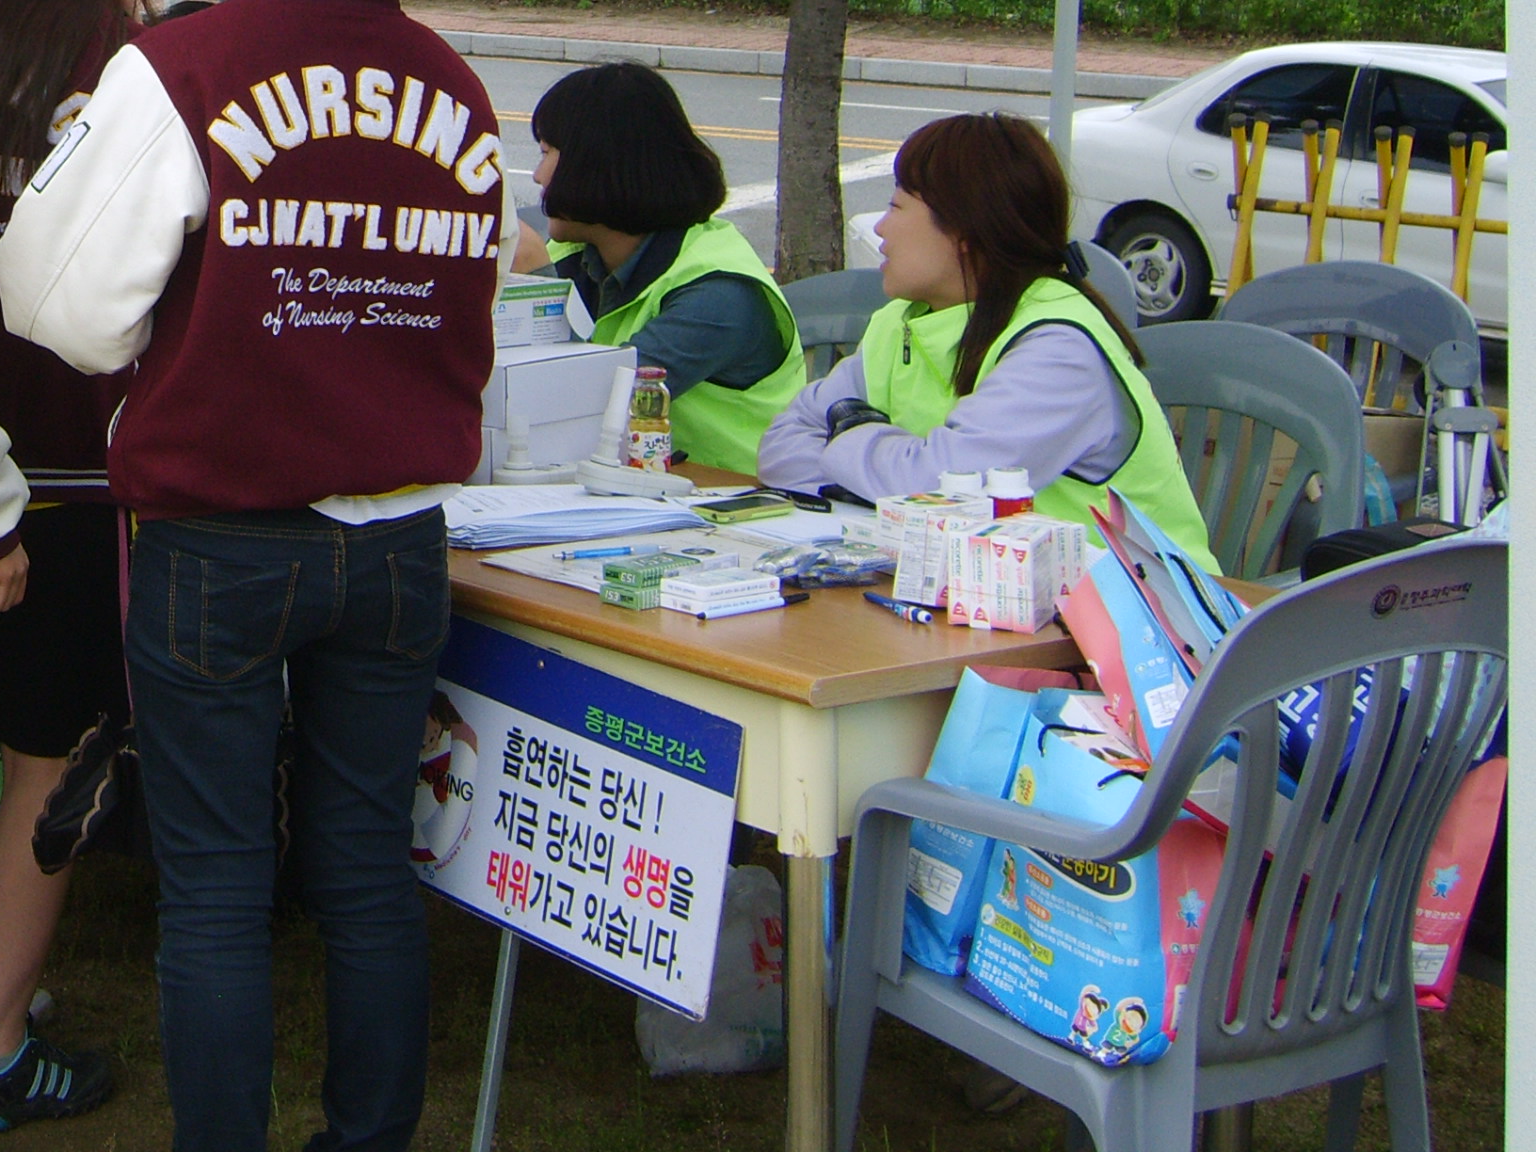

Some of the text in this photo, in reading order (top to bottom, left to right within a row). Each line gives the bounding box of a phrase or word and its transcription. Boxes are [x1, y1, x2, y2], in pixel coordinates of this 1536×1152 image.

[207, 64, 503, 195] NURSING
[394, 206, 499, 259] UNIV.
[262, 300, 442, 336] of Nursing Science
[271, 267, 434, 300] The Department
[502, 726, 592, 808] 흡연하는
[597, 765, 648, 831] 당신
[583, 704, 708, 775] 증평군보건소
[493, 789, 540, 852] 지금
[546, 809, 615, 886] 당신의
[622, 844, 695, 921] 생명을
[485, 849, 576, 929] 태워가고
[581, 892, 683, 982] 있습니다.
